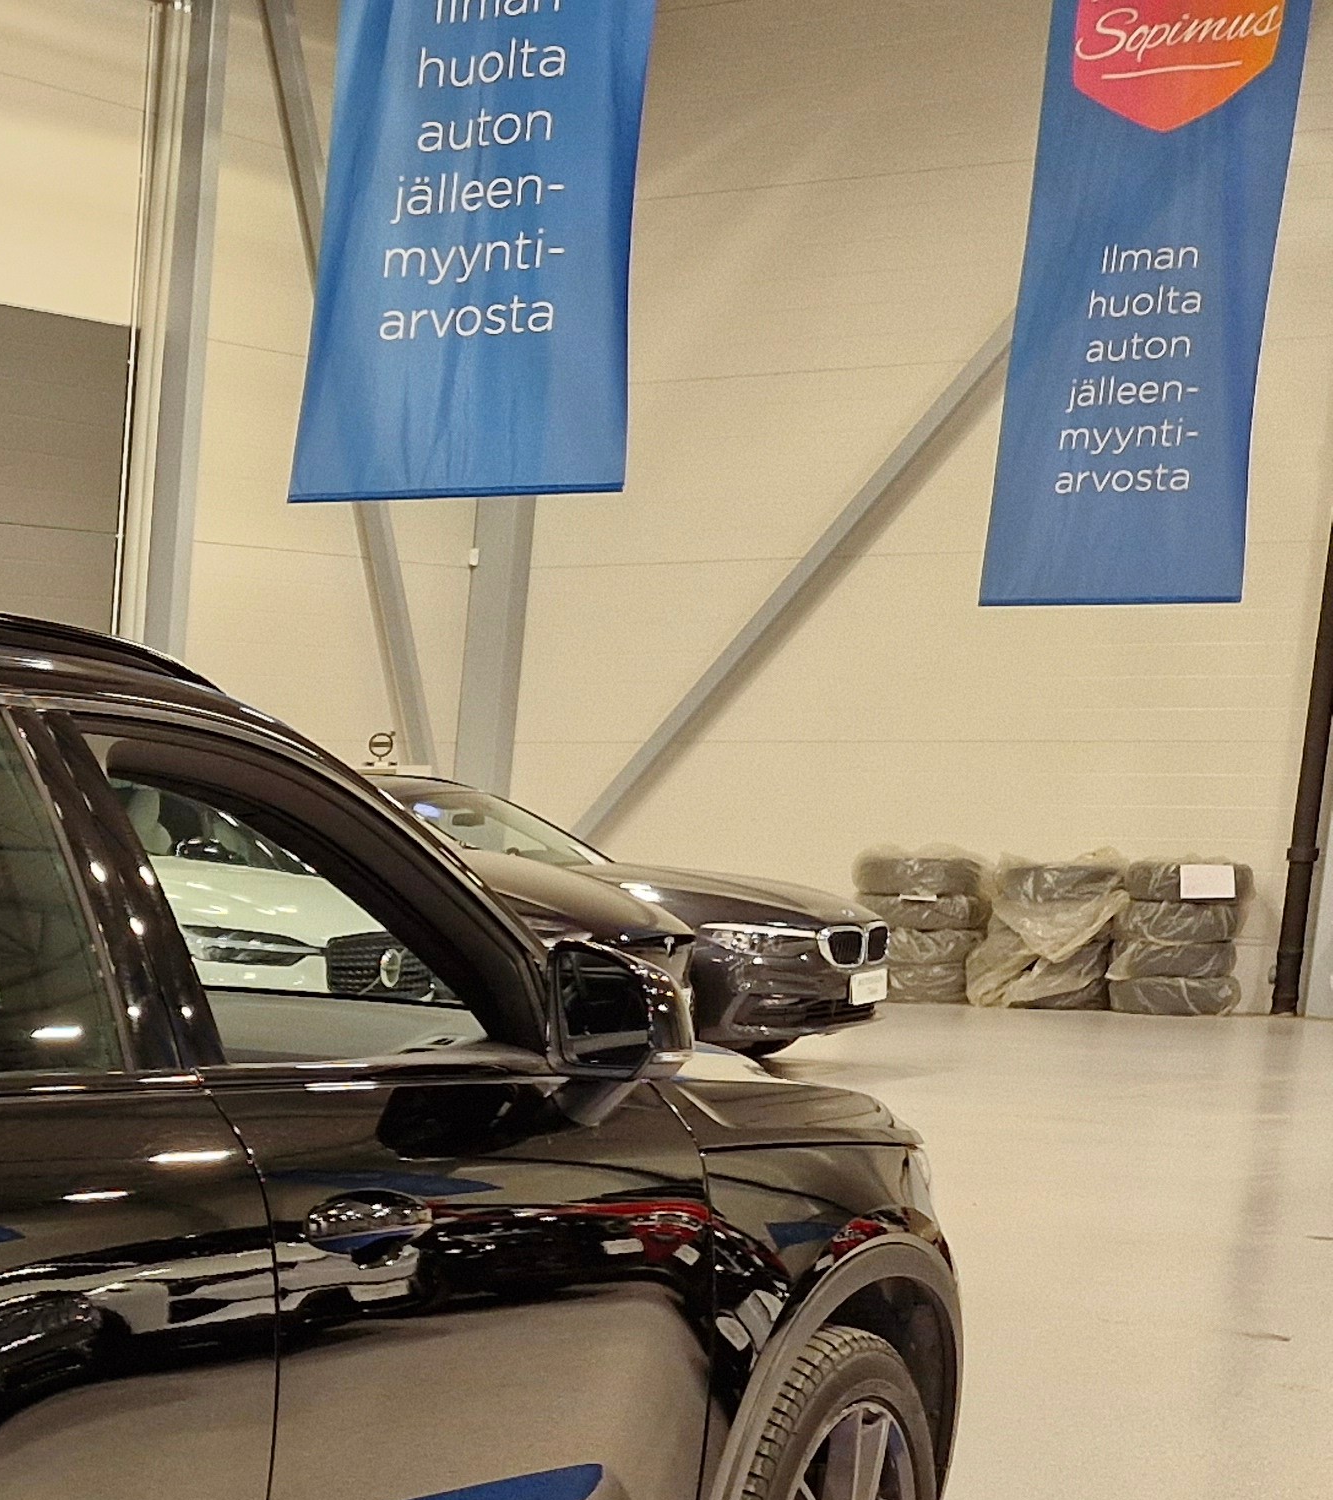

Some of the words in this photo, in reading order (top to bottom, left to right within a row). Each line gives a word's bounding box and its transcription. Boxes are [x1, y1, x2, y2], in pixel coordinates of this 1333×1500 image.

[1075, 4, 1282, 62] Sopimus
[417, 37, 566, 88] huolta
[417, 108, 553, 152] auton
[389, 171, 565, 224] jälleen-
[383, 227, 565, 286] myynti-
[1101, 244, 1199, 273] Ilman
[379, 295, 555, 341] arvosta
[1088, 285, 1202, 319] huolta
[1085, 332, 1191, 362] auton
[1065, 375, 1199, 413] jälleen-
[1058, 418, 1199, 455] myynti-
[1054, 463, 1190, 494] arvosta
